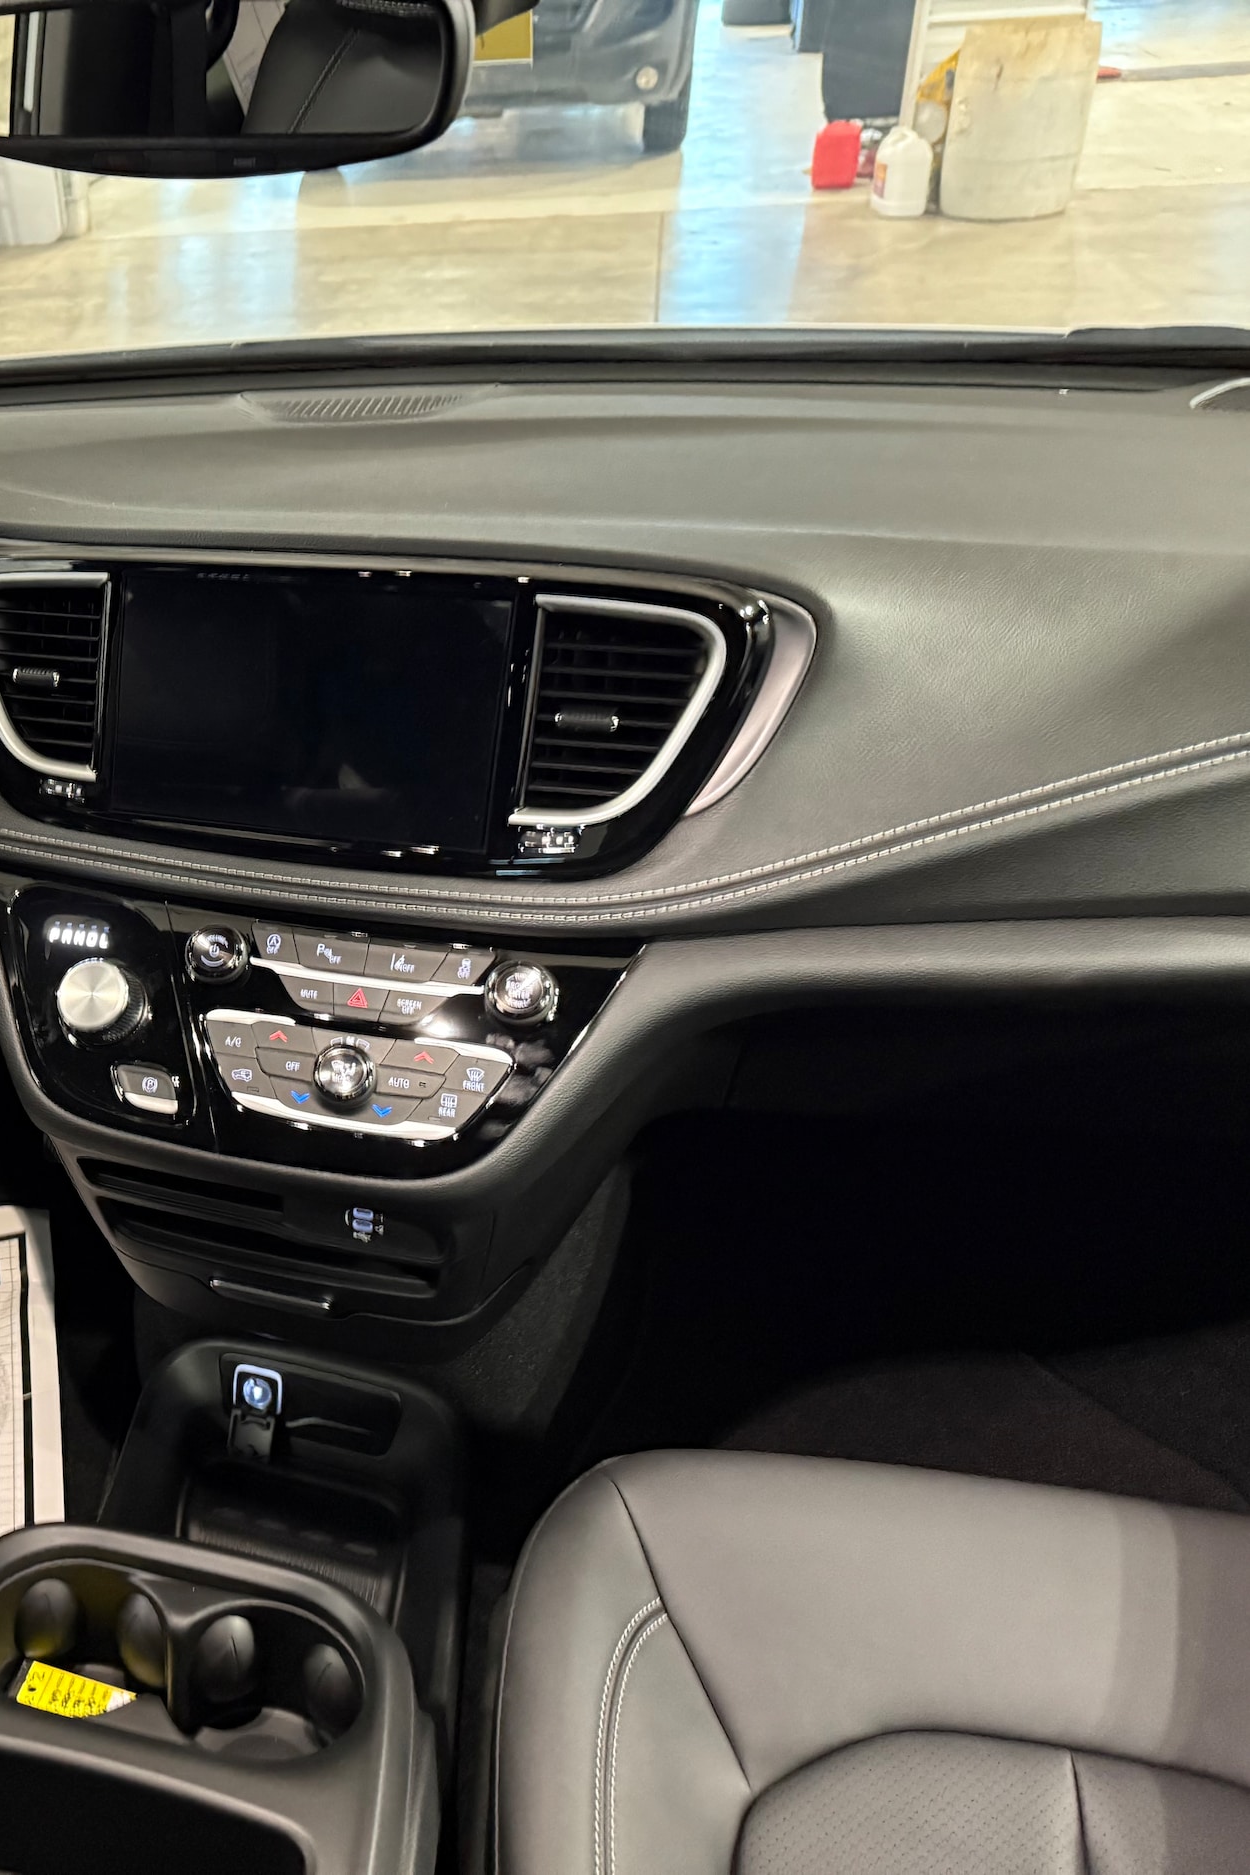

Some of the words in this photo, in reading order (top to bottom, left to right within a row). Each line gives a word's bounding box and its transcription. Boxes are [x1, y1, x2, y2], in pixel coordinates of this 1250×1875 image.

[225, 1036, 241, 1047] A/C
[285, 1061, 300, 1072] OFF
[388, 1076, 410, 1089] AUTO
[462, 1080, 485, 1093] FRONT
[438, 1106, 456, 1118] REAR
